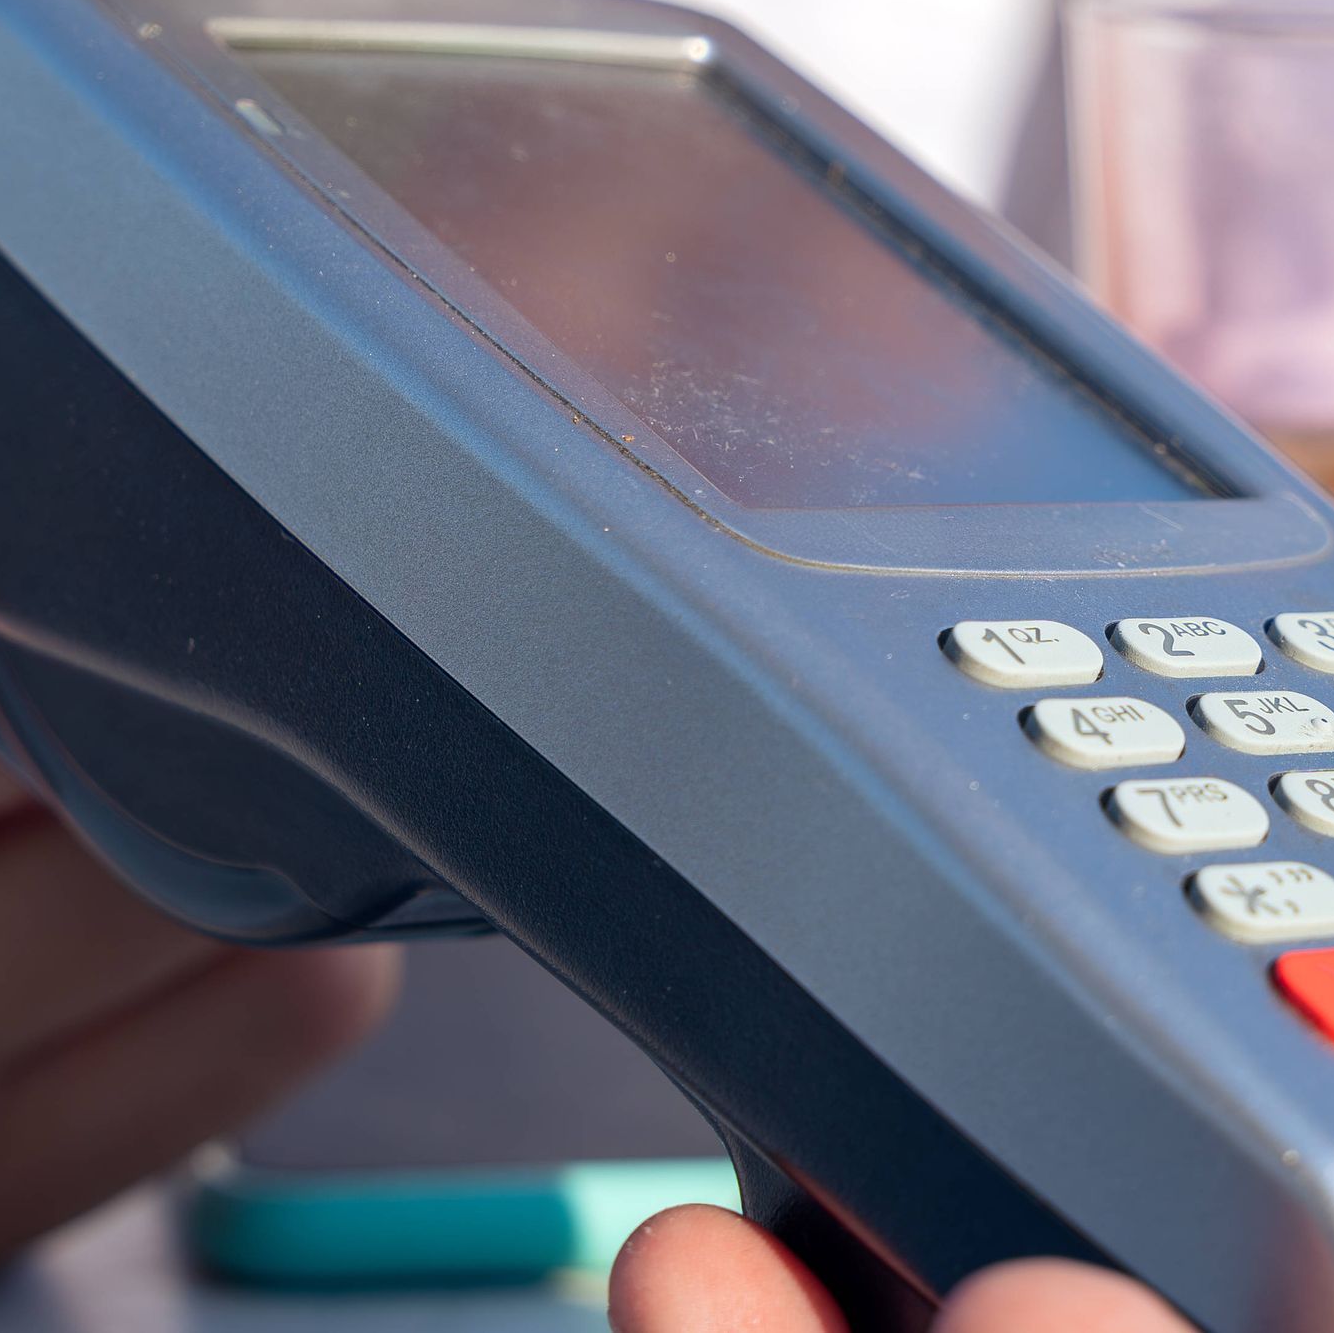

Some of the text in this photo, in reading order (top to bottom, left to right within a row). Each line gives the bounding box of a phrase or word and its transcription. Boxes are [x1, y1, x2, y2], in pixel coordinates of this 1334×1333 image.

[982, 627, 1025, 665] 1
[1138, 621, 1227, 656] 2 ABC
[1071, 705, 1146, 745] 4 GHI
[1223, 697, 1309, 735] 5 JKL
[1135, 784, 1229, 827] 7 PRS
